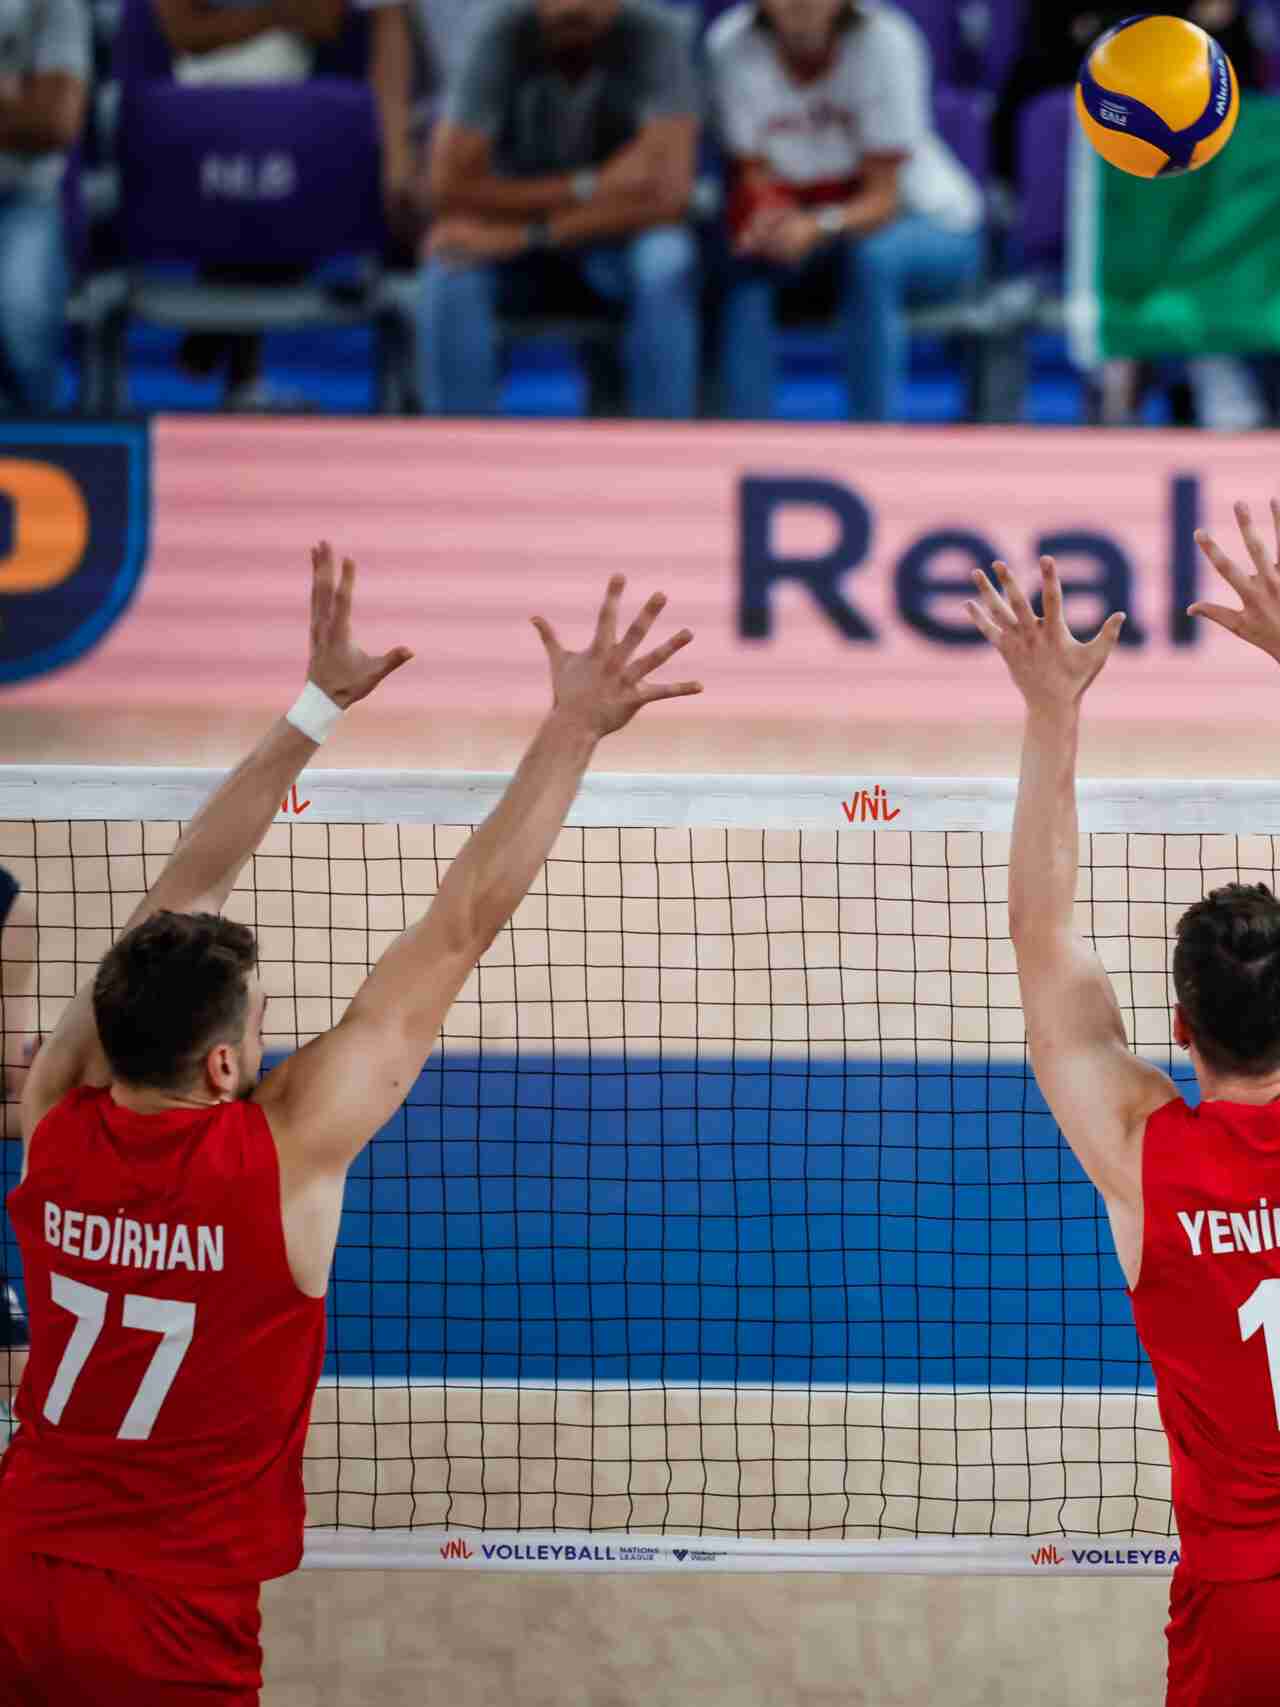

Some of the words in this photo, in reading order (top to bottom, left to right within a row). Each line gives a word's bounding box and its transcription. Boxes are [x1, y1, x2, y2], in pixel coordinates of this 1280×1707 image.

[733, 472, 1201, 652] Real
[841, 784, 900, 822] VNL
[43, 1201, 224, 1272] BEDİRHAN
[42, 1271, 196, 1440] 77
[440, 1538, 472, 1560] VNL
[482, 1545, 616, 1560] VOLLEYBALL
[1032, 1544, 1064, 1565] VNL
[1072, 1550, 1181, 1564] VOLLEYBA
